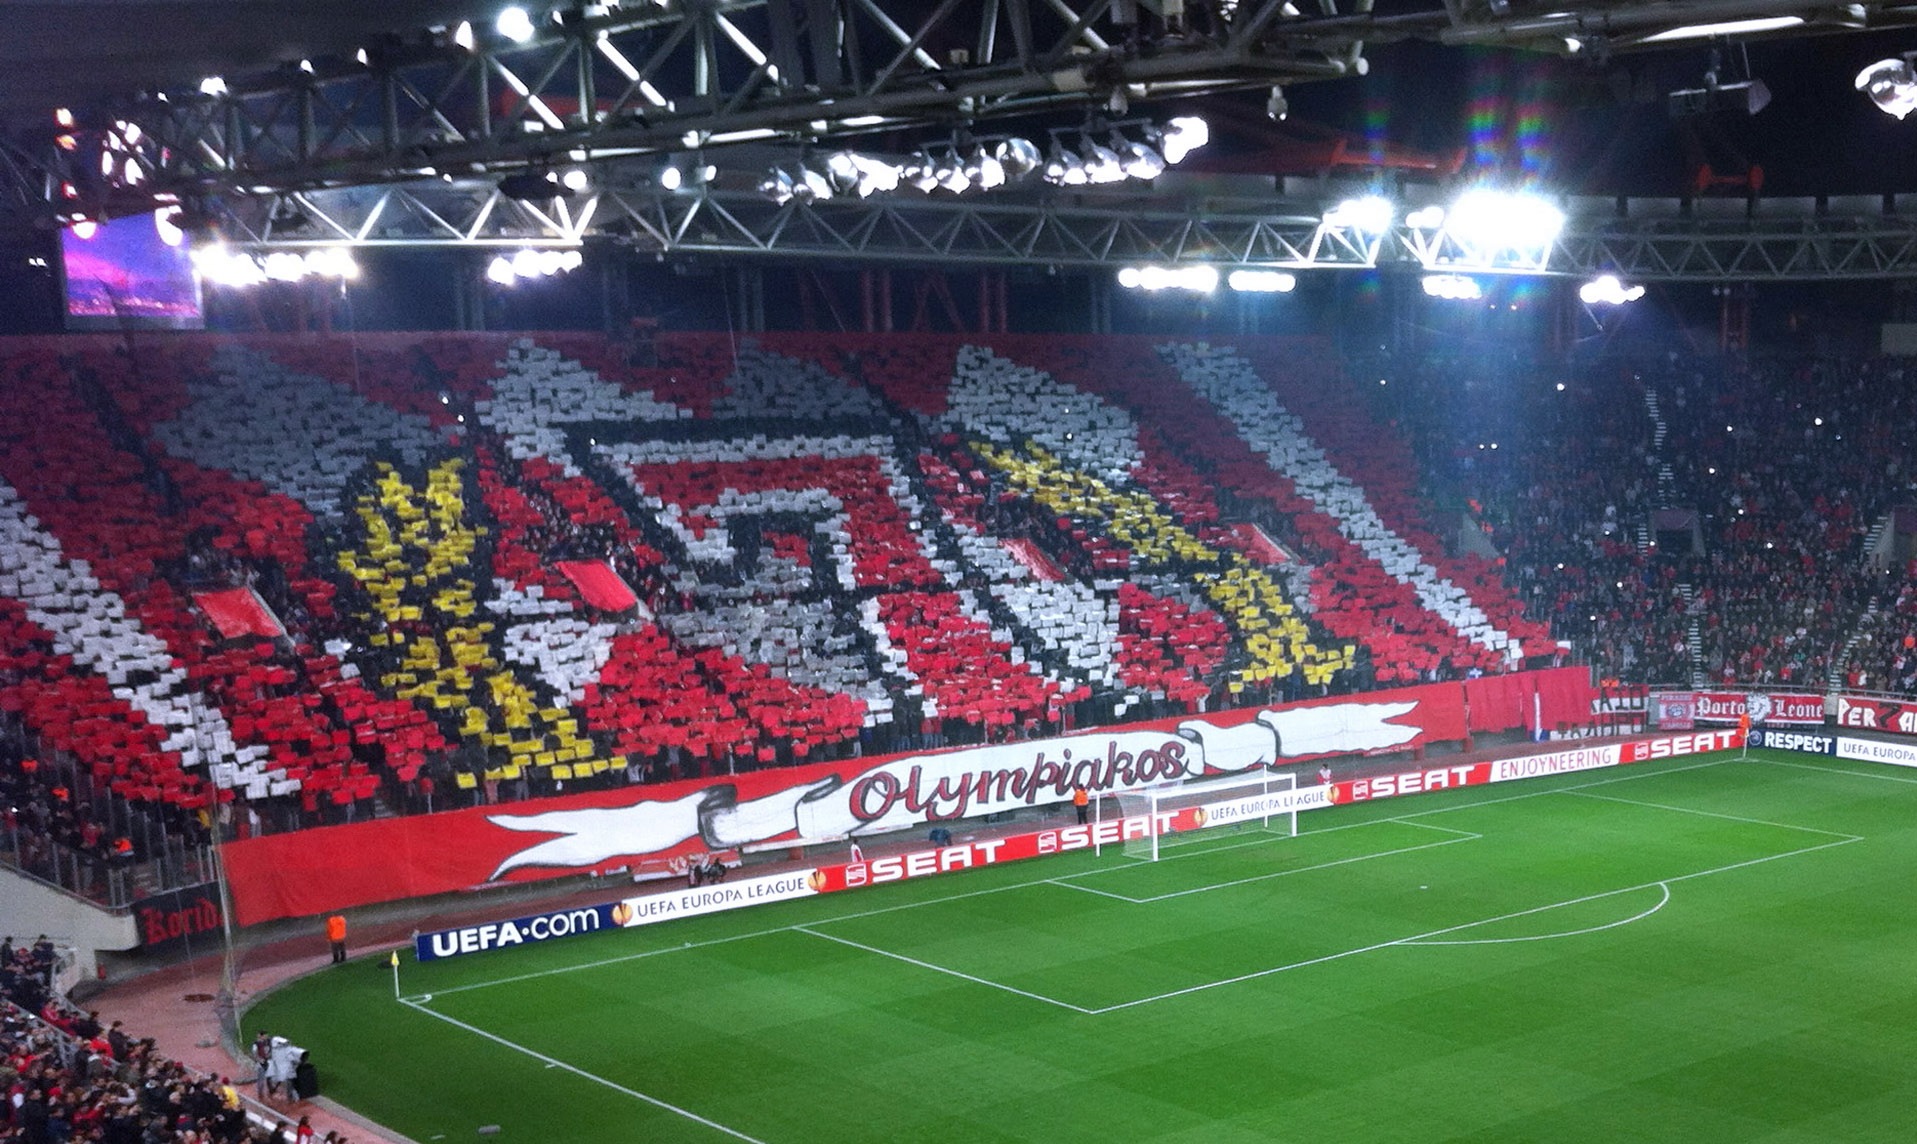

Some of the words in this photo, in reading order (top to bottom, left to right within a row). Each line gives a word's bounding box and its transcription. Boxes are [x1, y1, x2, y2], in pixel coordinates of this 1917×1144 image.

[1696, 696, 1746, 719] Porto
[1774, 699, 1823, 718] Leone
[1651, 730, 1737, 758] SEAT
[1764, 732, 1833, 753] RESPECT
[1843, 743, 1870, 755] UEFA
[1873, 747, 1916, 761] EUROPA
[1500, 748, 1611, 778] ENJOYNEERING
[850, 740, 1187, 822] Olympiakos
[1371, 765, 1475, 797] SEAT
[1211, 807, 1238, 820] UEFA
[1061, 811, 1179, 849] SEAT
[871, 839, 1006, 883] SEAT
[637, 900, 677, 917] UEFA
[682, 889, 743, 910] EUROPA
[748, 878, 805, 899] LEAGUE
